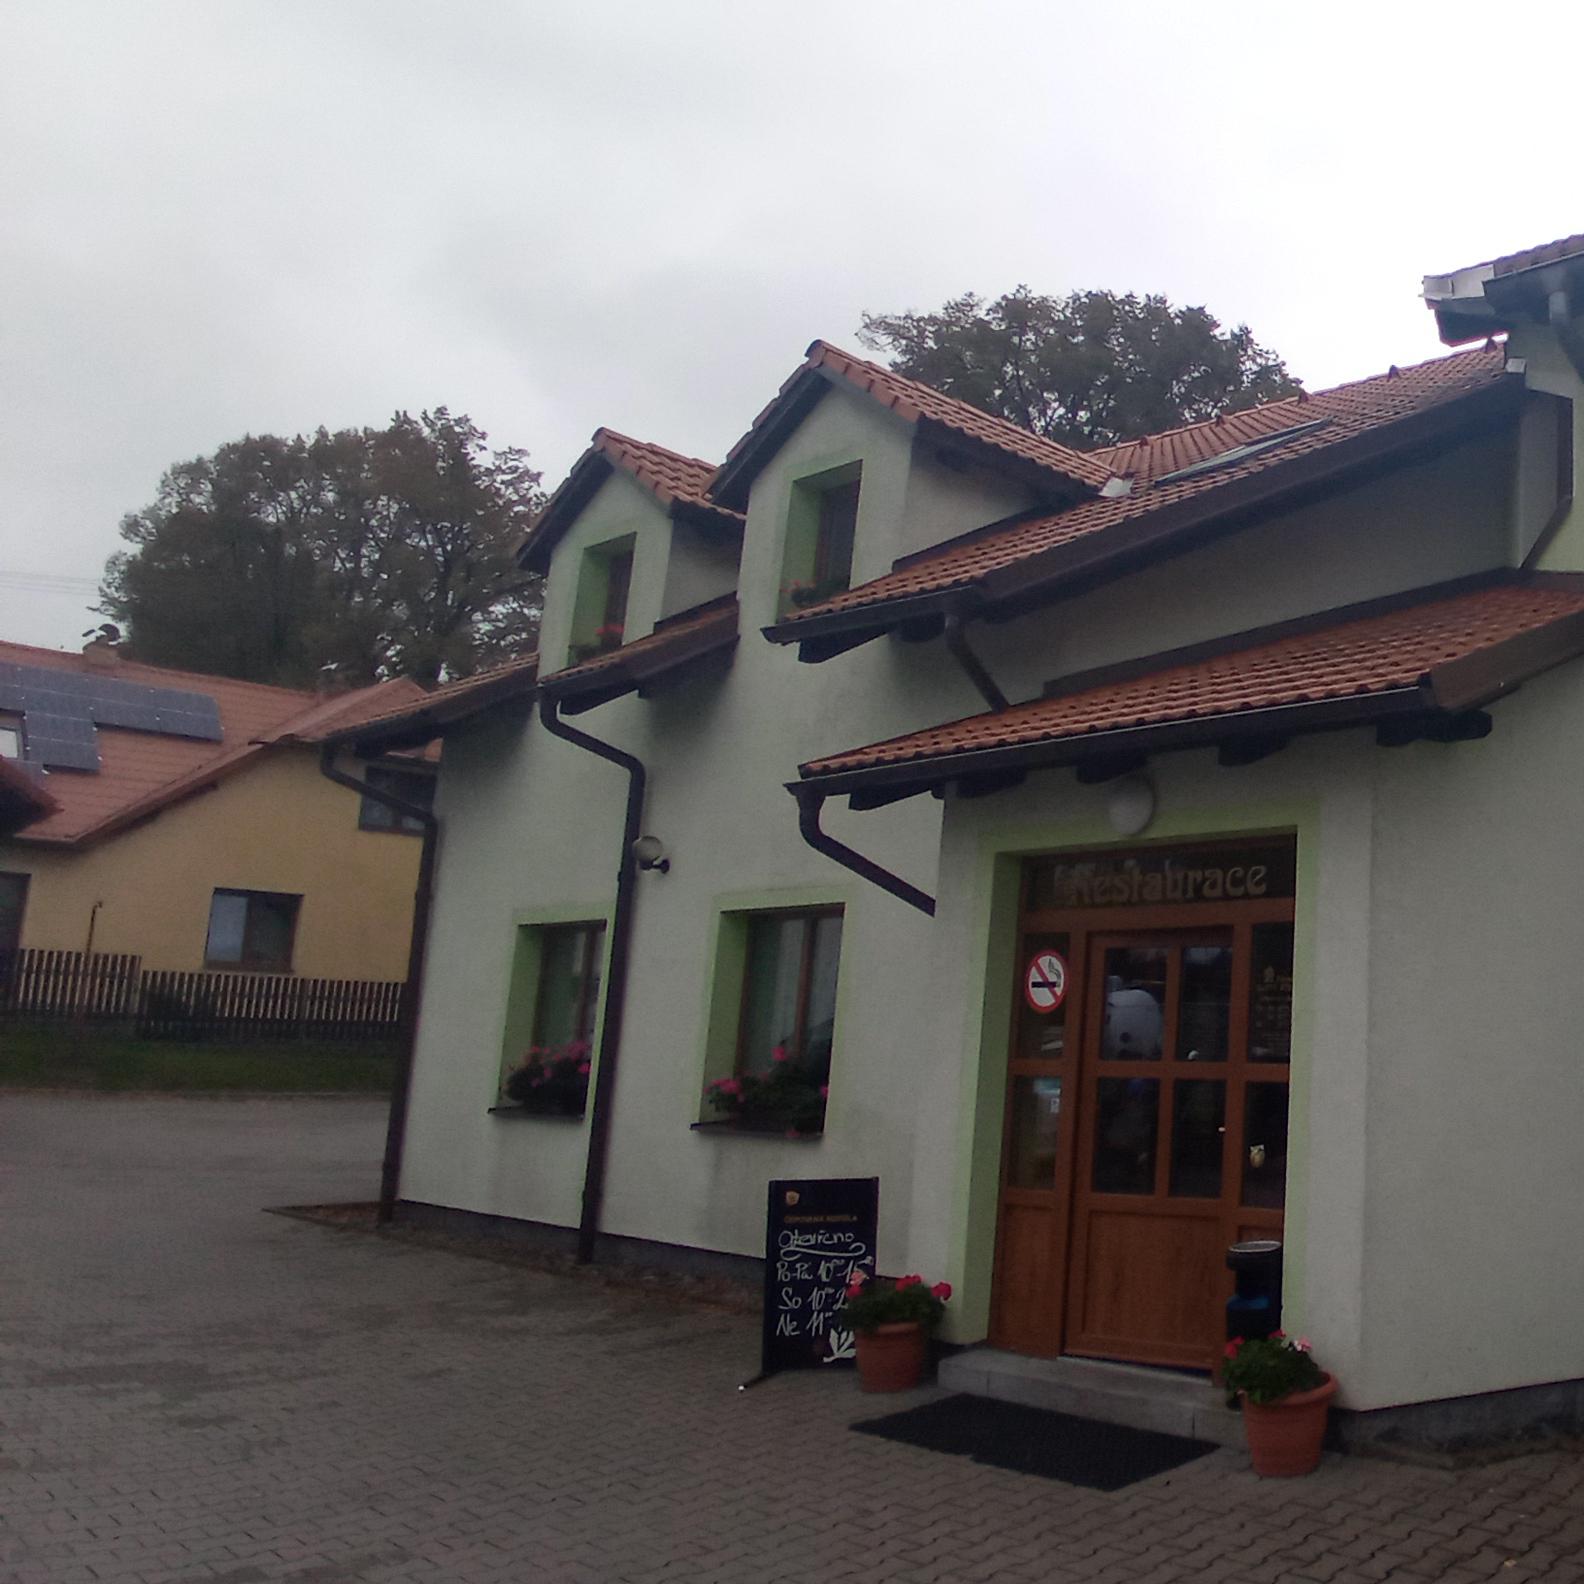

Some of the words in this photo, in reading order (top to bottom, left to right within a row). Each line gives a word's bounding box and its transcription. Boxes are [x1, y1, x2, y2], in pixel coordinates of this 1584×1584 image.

[1056, 859, 1267, 907] Restaurace
[778, 1286, 802, 1310] So
[776, 1313, 801, 1337] Ne
